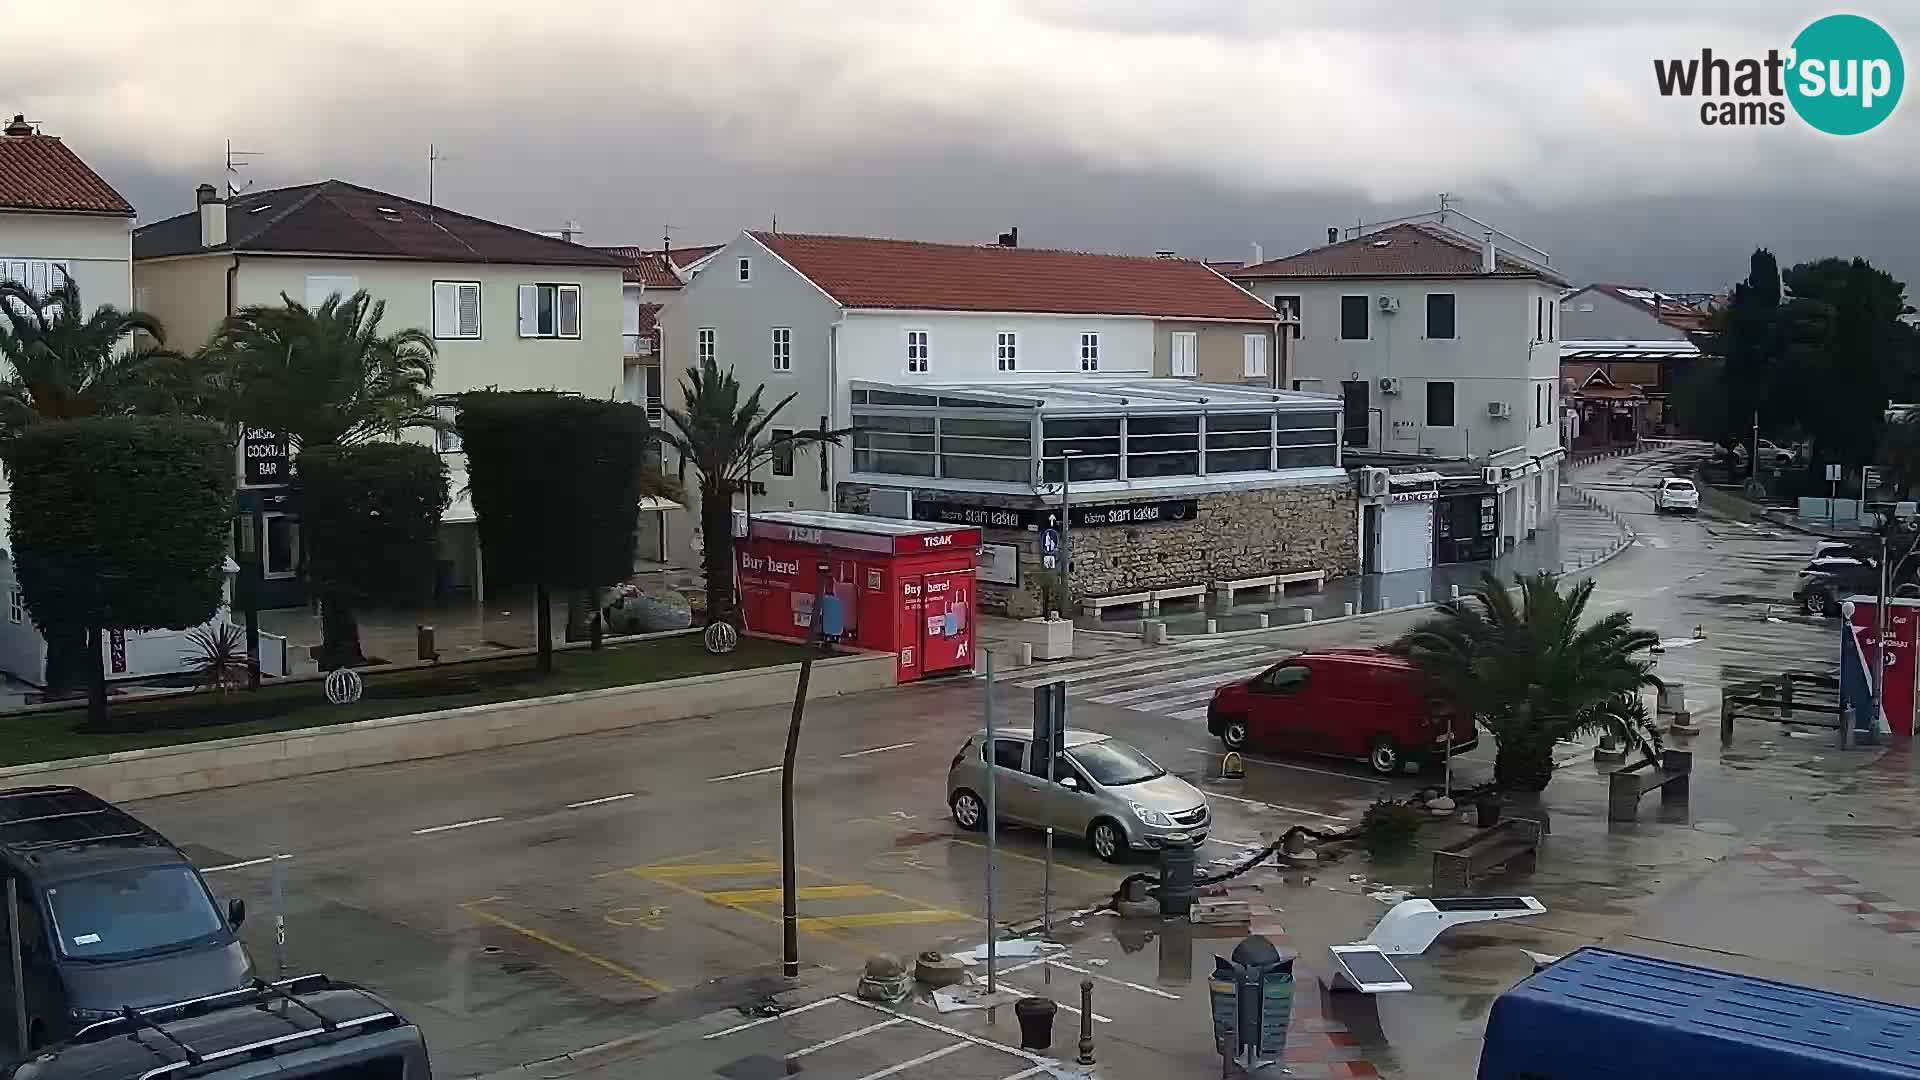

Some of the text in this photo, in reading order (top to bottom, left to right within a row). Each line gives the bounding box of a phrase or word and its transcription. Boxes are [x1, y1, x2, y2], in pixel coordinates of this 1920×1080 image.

[259, 462, 277, 475] BAR
[1084, 513, 1106, 524] bistro
[923, 534, 953, 547] TISAK
[742, 551, 800, 577] Buy here!
[904, 583, 922, 597] Buy
